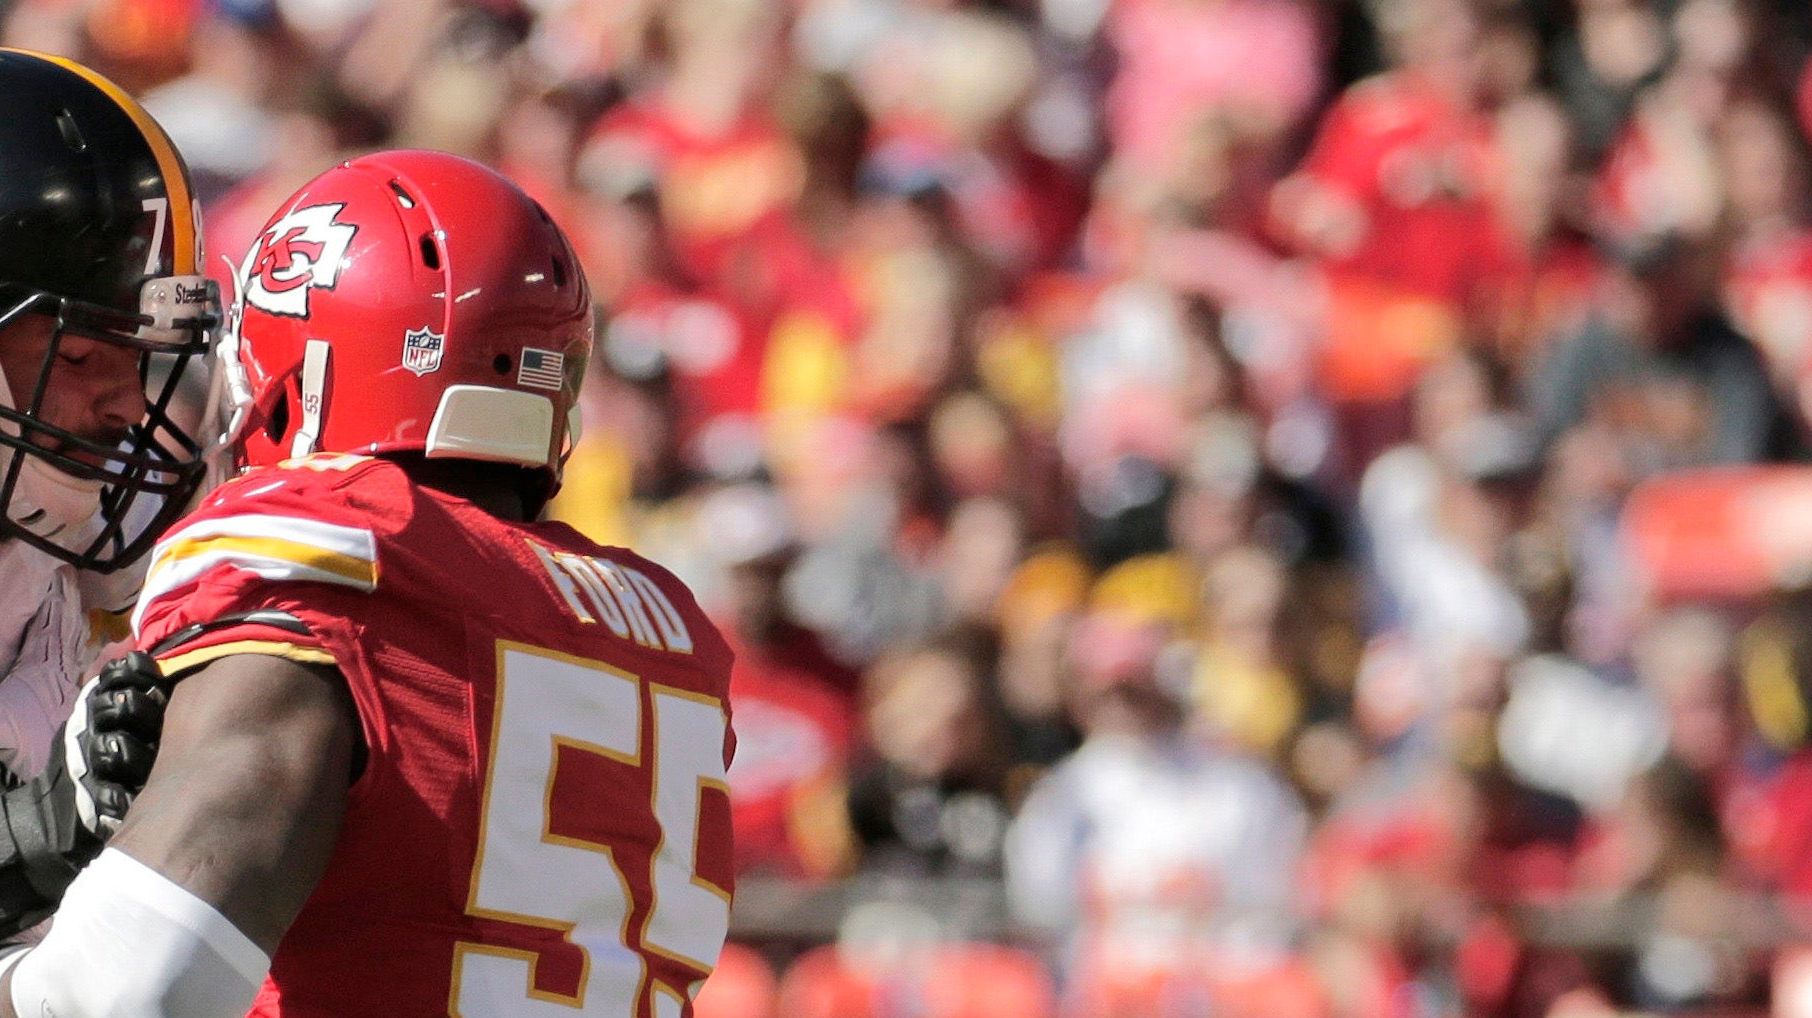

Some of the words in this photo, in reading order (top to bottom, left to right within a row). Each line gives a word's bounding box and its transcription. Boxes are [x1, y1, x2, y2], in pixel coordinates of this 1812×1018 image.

[409, 349, 435, 367] NFL
[304, 393, 319, 414] 55
[524, 537, 693, 654] FORD
